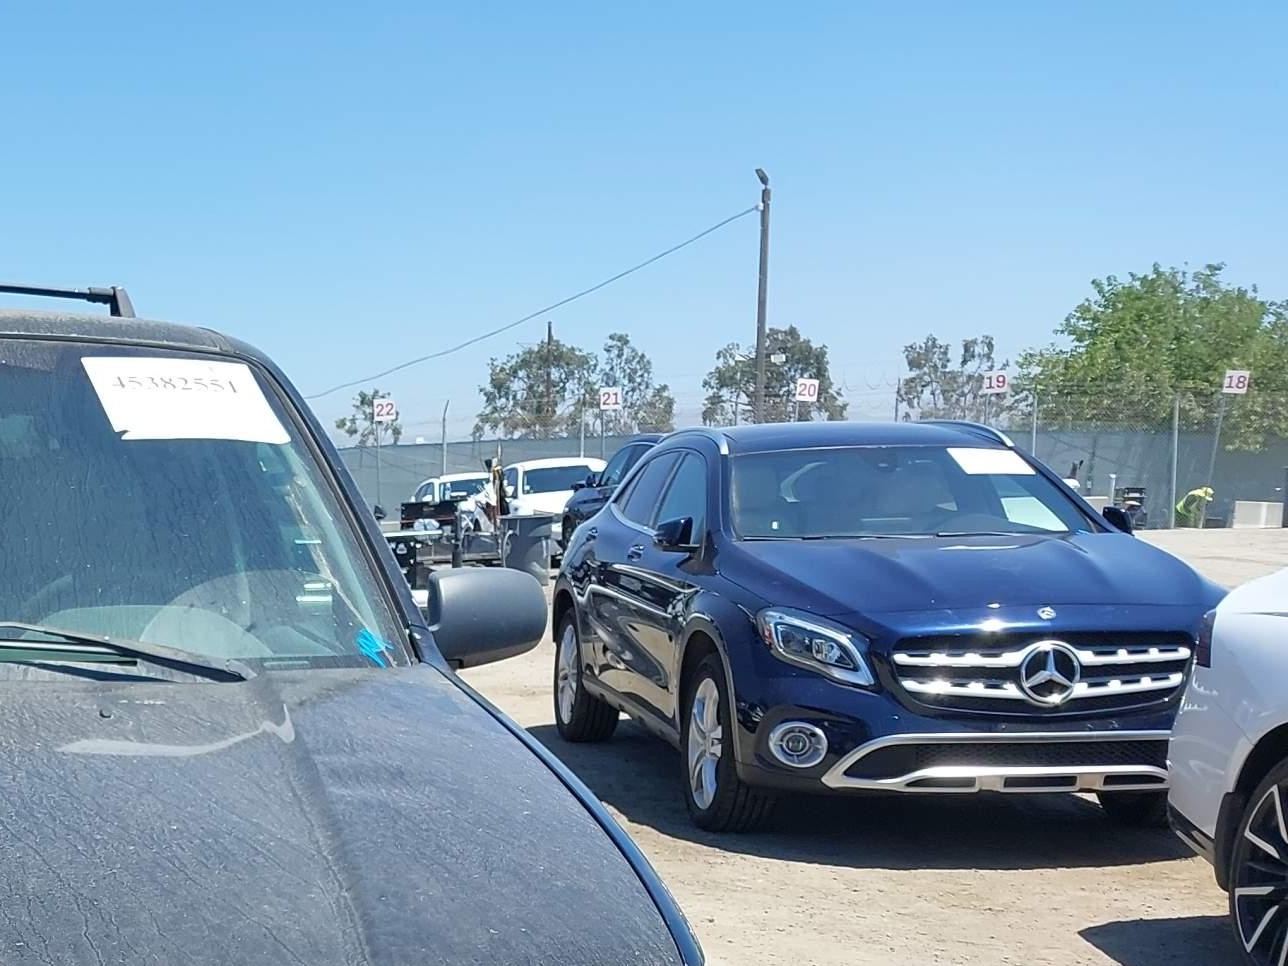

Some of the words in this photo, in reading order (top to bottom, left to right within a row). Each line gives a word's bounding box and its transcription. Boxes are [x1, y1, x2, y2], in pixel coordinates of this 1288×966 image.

[986, 374, 1006, 390] 19
[1225, 375, 1247, 390] 18
[798, 383, 816, 398] 20
[602, 391, 620, 406] 21
[376, 402, 394, 417] 22
